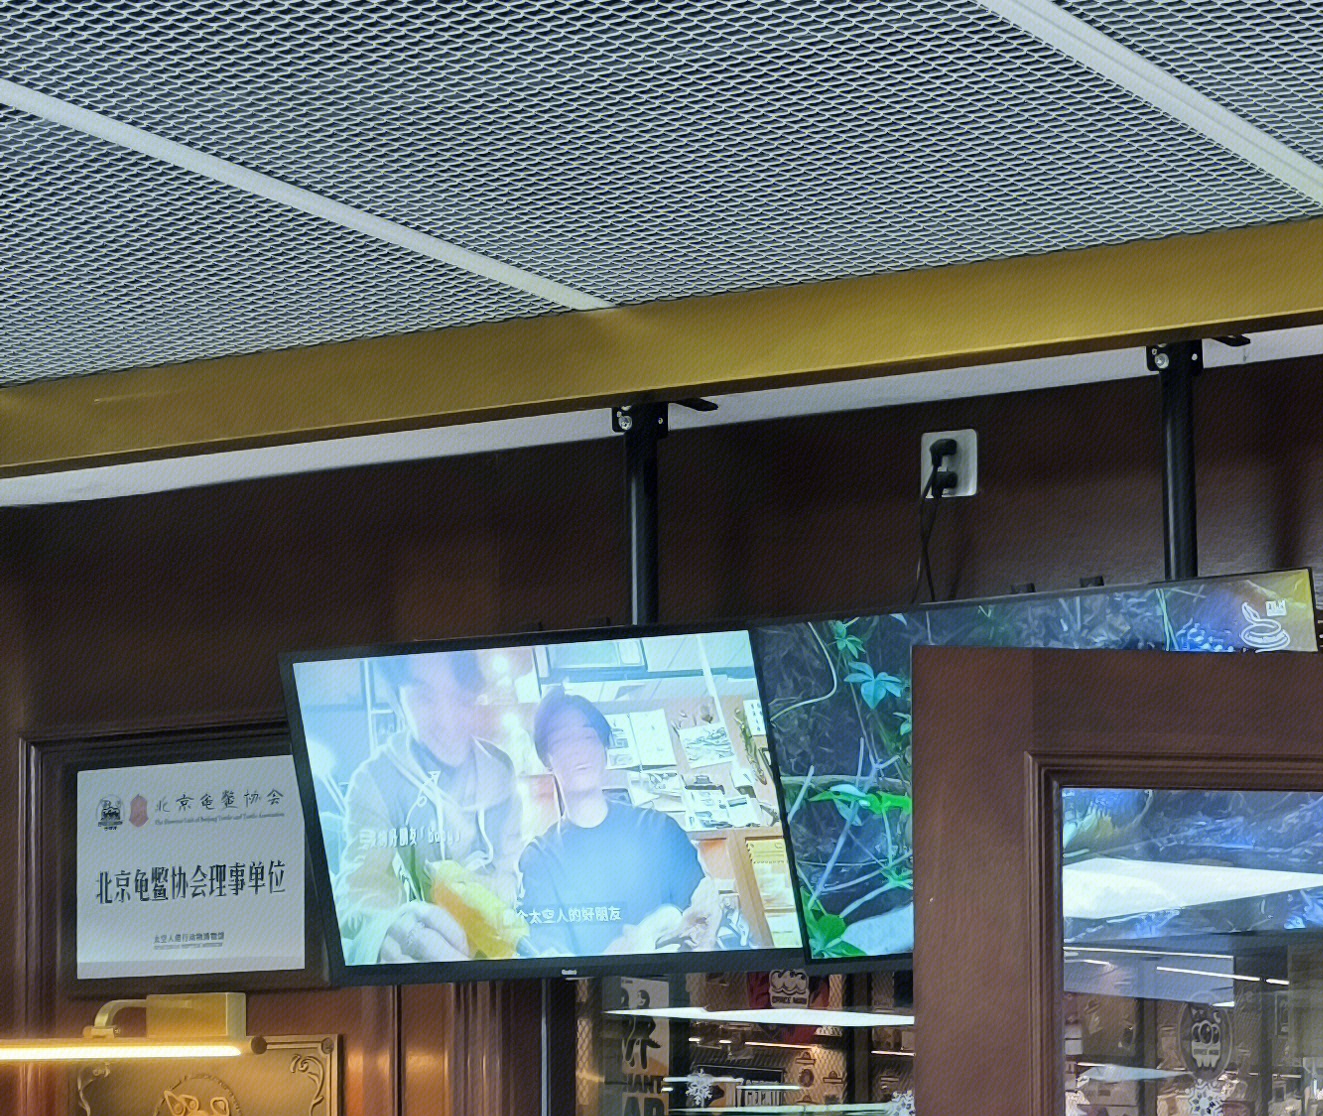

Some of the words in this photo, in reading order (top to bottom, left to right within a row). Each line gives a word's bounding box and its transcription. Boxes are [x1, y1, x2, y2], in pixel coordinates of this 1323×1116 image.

[96, 859, 286, 905] 北京龟鳖协会理事单位
